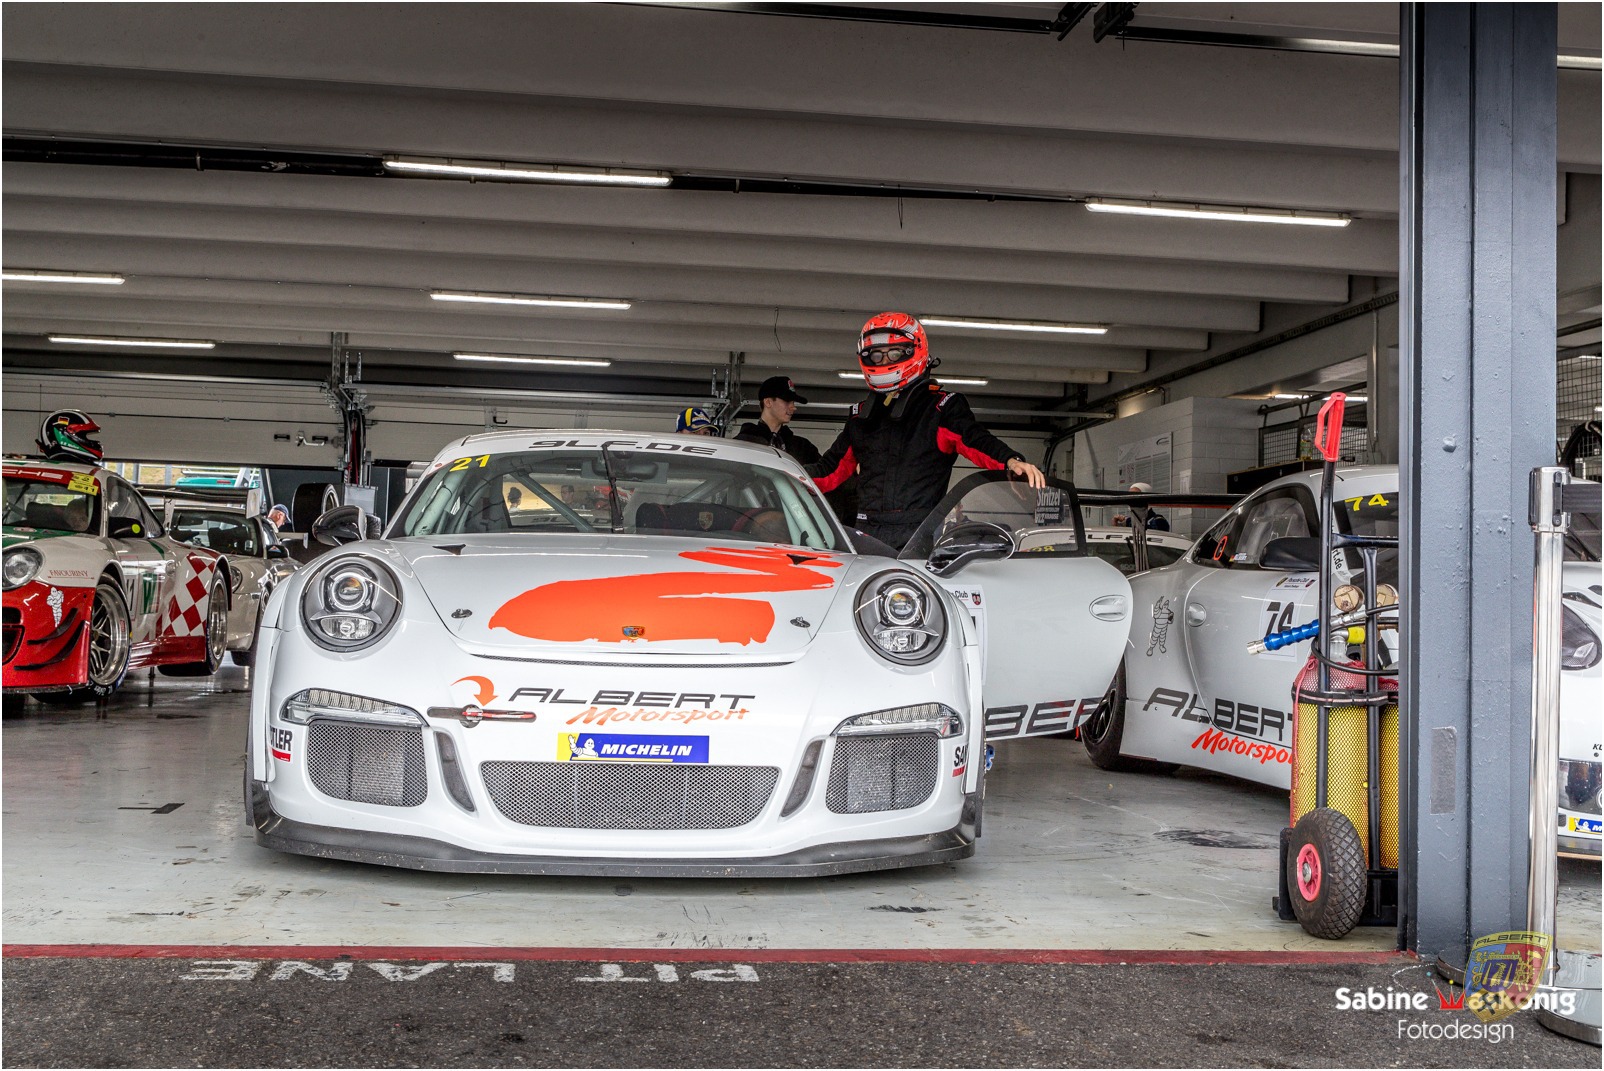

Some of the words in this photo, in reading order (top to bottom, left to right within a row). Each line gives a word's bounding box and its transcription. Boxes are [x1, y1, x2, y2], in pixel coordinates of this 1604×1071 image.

[529, 439, 718, 456] 9LF.DE
[450, 454, 491, 472] 21
[1344, 493, 1389, 511] 74
[508, 687, 756, 710] ALBERT
[566, 706, 750, 726] Motorsport
[1142, 687, 1293, 742] ALBER
[600, 743, 692, 756] MICHELIN
[178, 961, 515, 983] LANE
[574, 963, 760, 983] PIT
